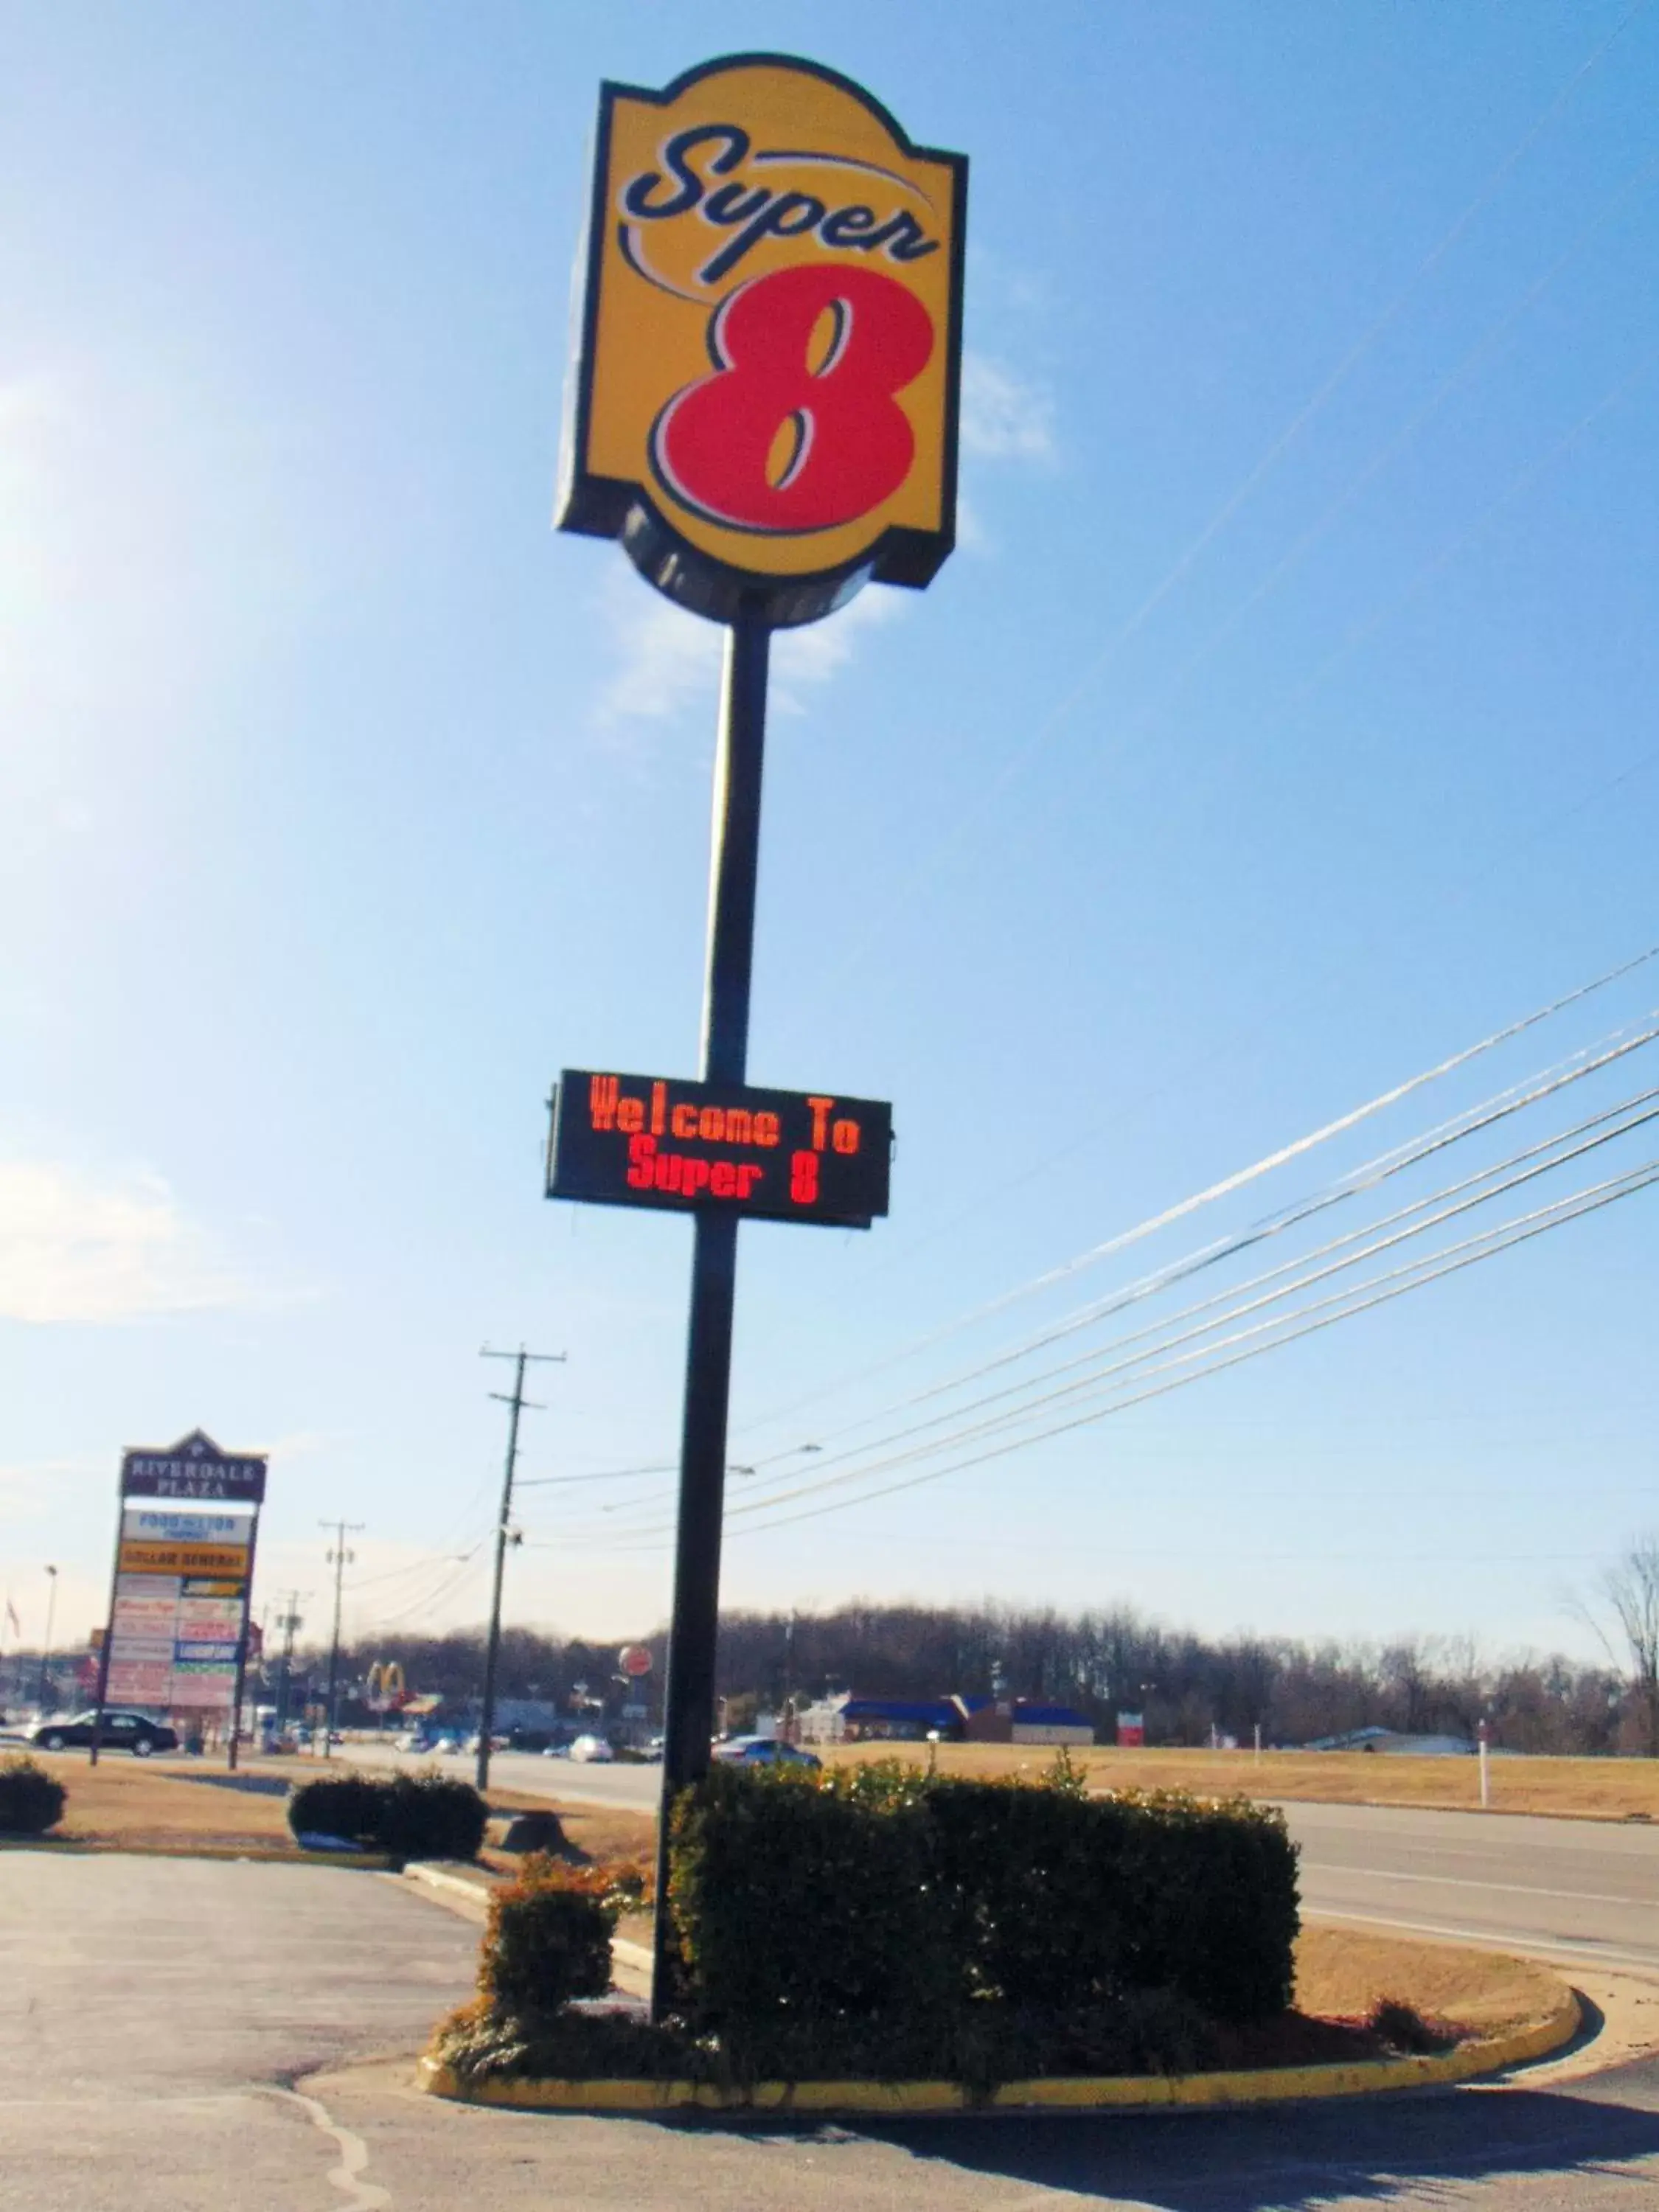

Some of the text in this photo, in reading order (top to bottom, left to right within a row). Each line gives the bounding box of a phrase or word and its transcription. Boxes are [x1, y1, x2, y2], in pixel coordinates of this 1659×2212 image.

[622, 123, 940, 285] Super
[647, 262, 935, 538] 8
[591, 1075, 860, 1154] Welcome To
[627, 1133, 819, 1203] Super 8
[131, 1460, 255, 1481] RIVERDALE
[157, 1478, 226, 1497] PLAZA
